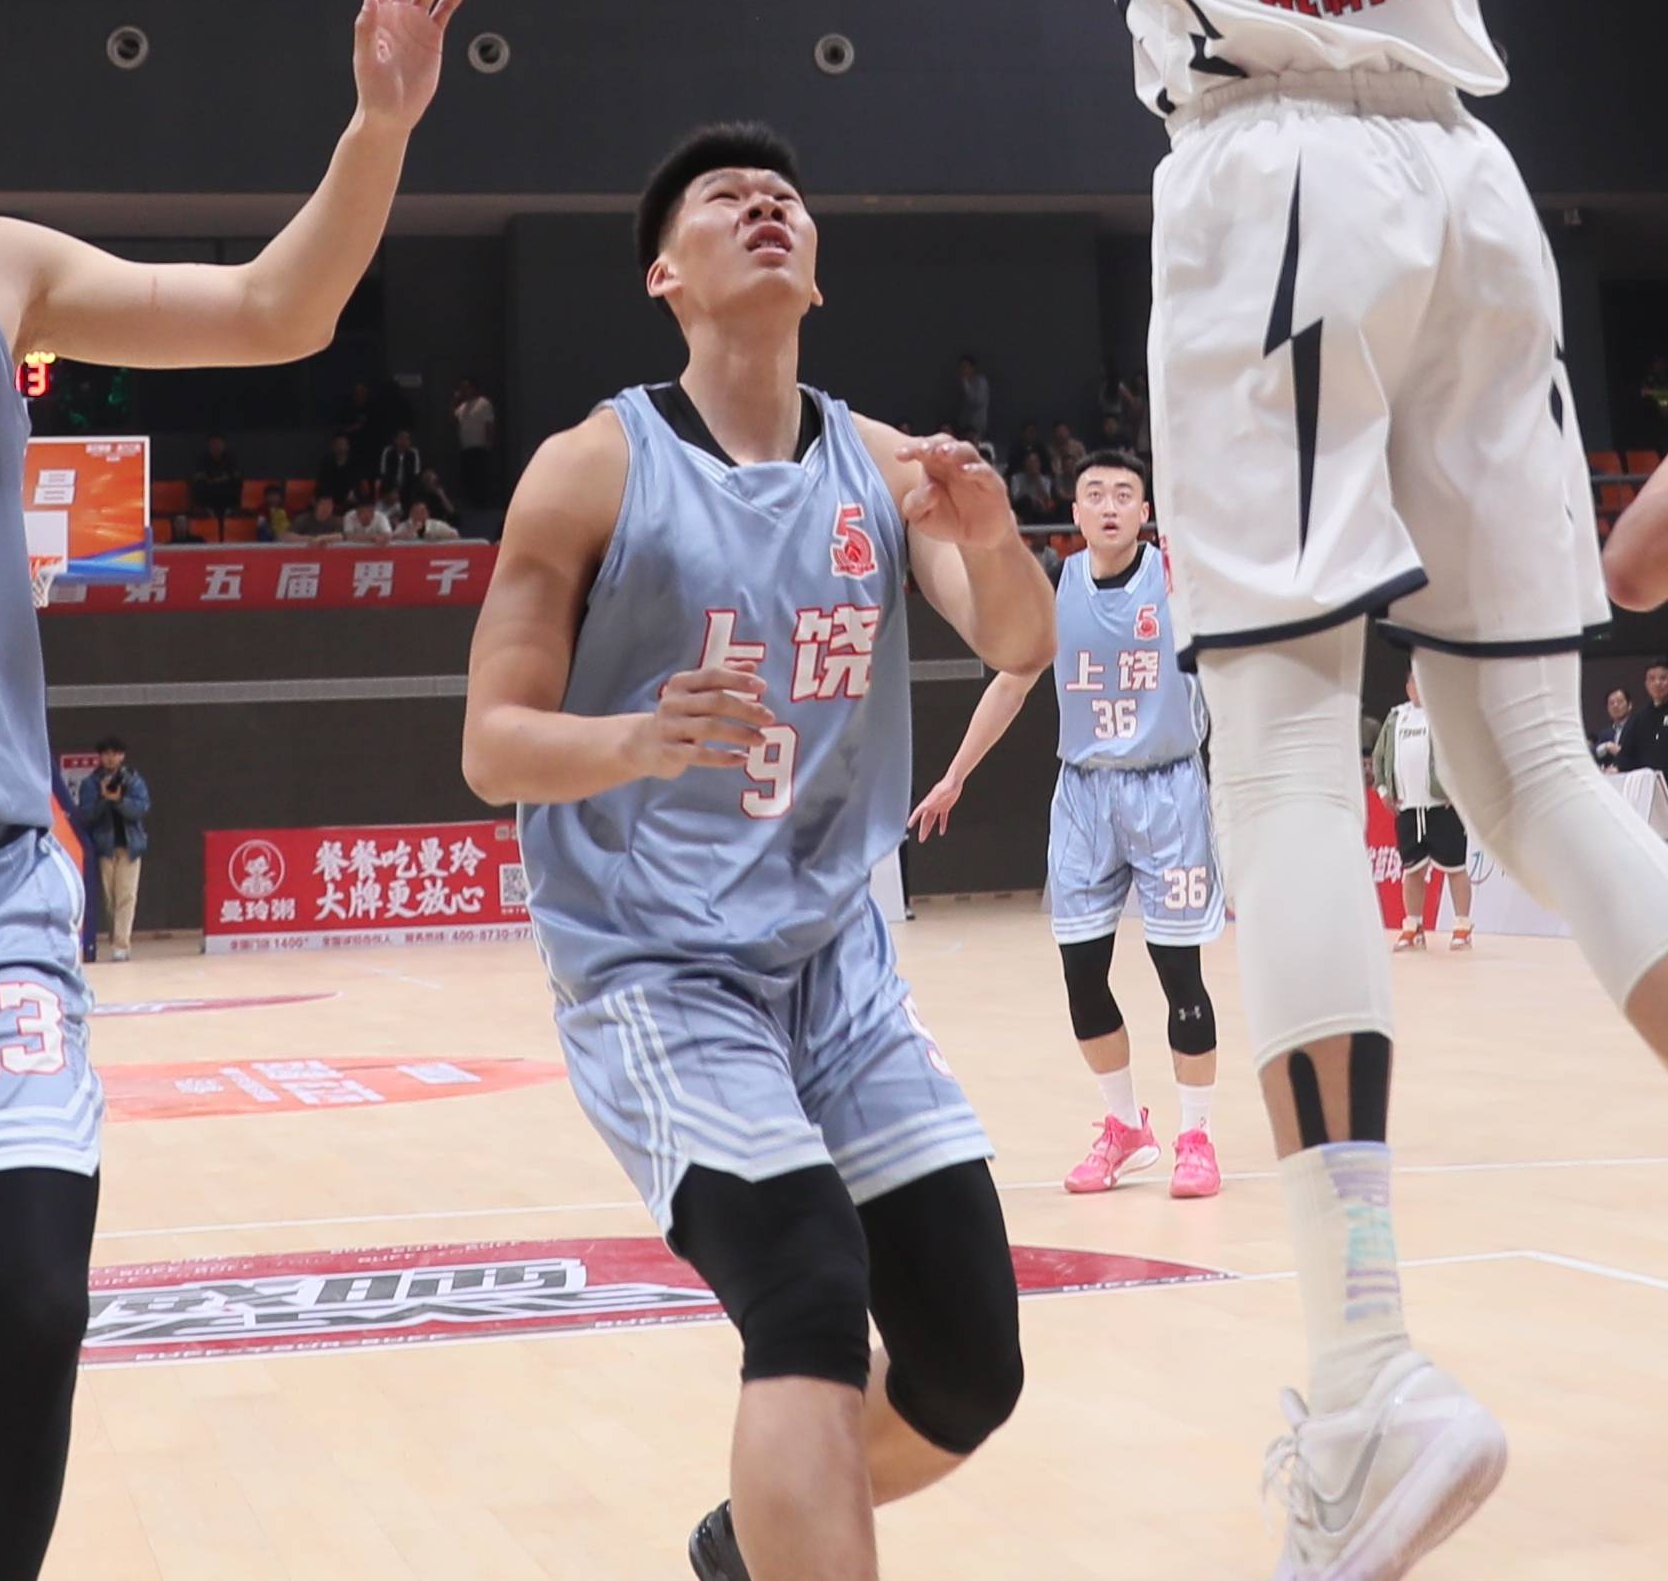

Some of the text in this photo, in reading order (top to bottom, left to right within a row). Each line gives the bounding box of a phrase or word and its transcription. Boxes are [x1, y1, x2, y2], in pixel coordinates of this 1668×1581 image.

[1065, 649, 1161, 692] 上饶
[1091, 699, 1139, 739] 36
[740, 723, 799, 819] 9
[312, 836, 486, 883] 餐餐吃曼玲
[314, 878, 485, 920] 大牌更放心
[1163, 865, 1208, 911] 36
[219, 898, 297, 923] 曼玲粥
